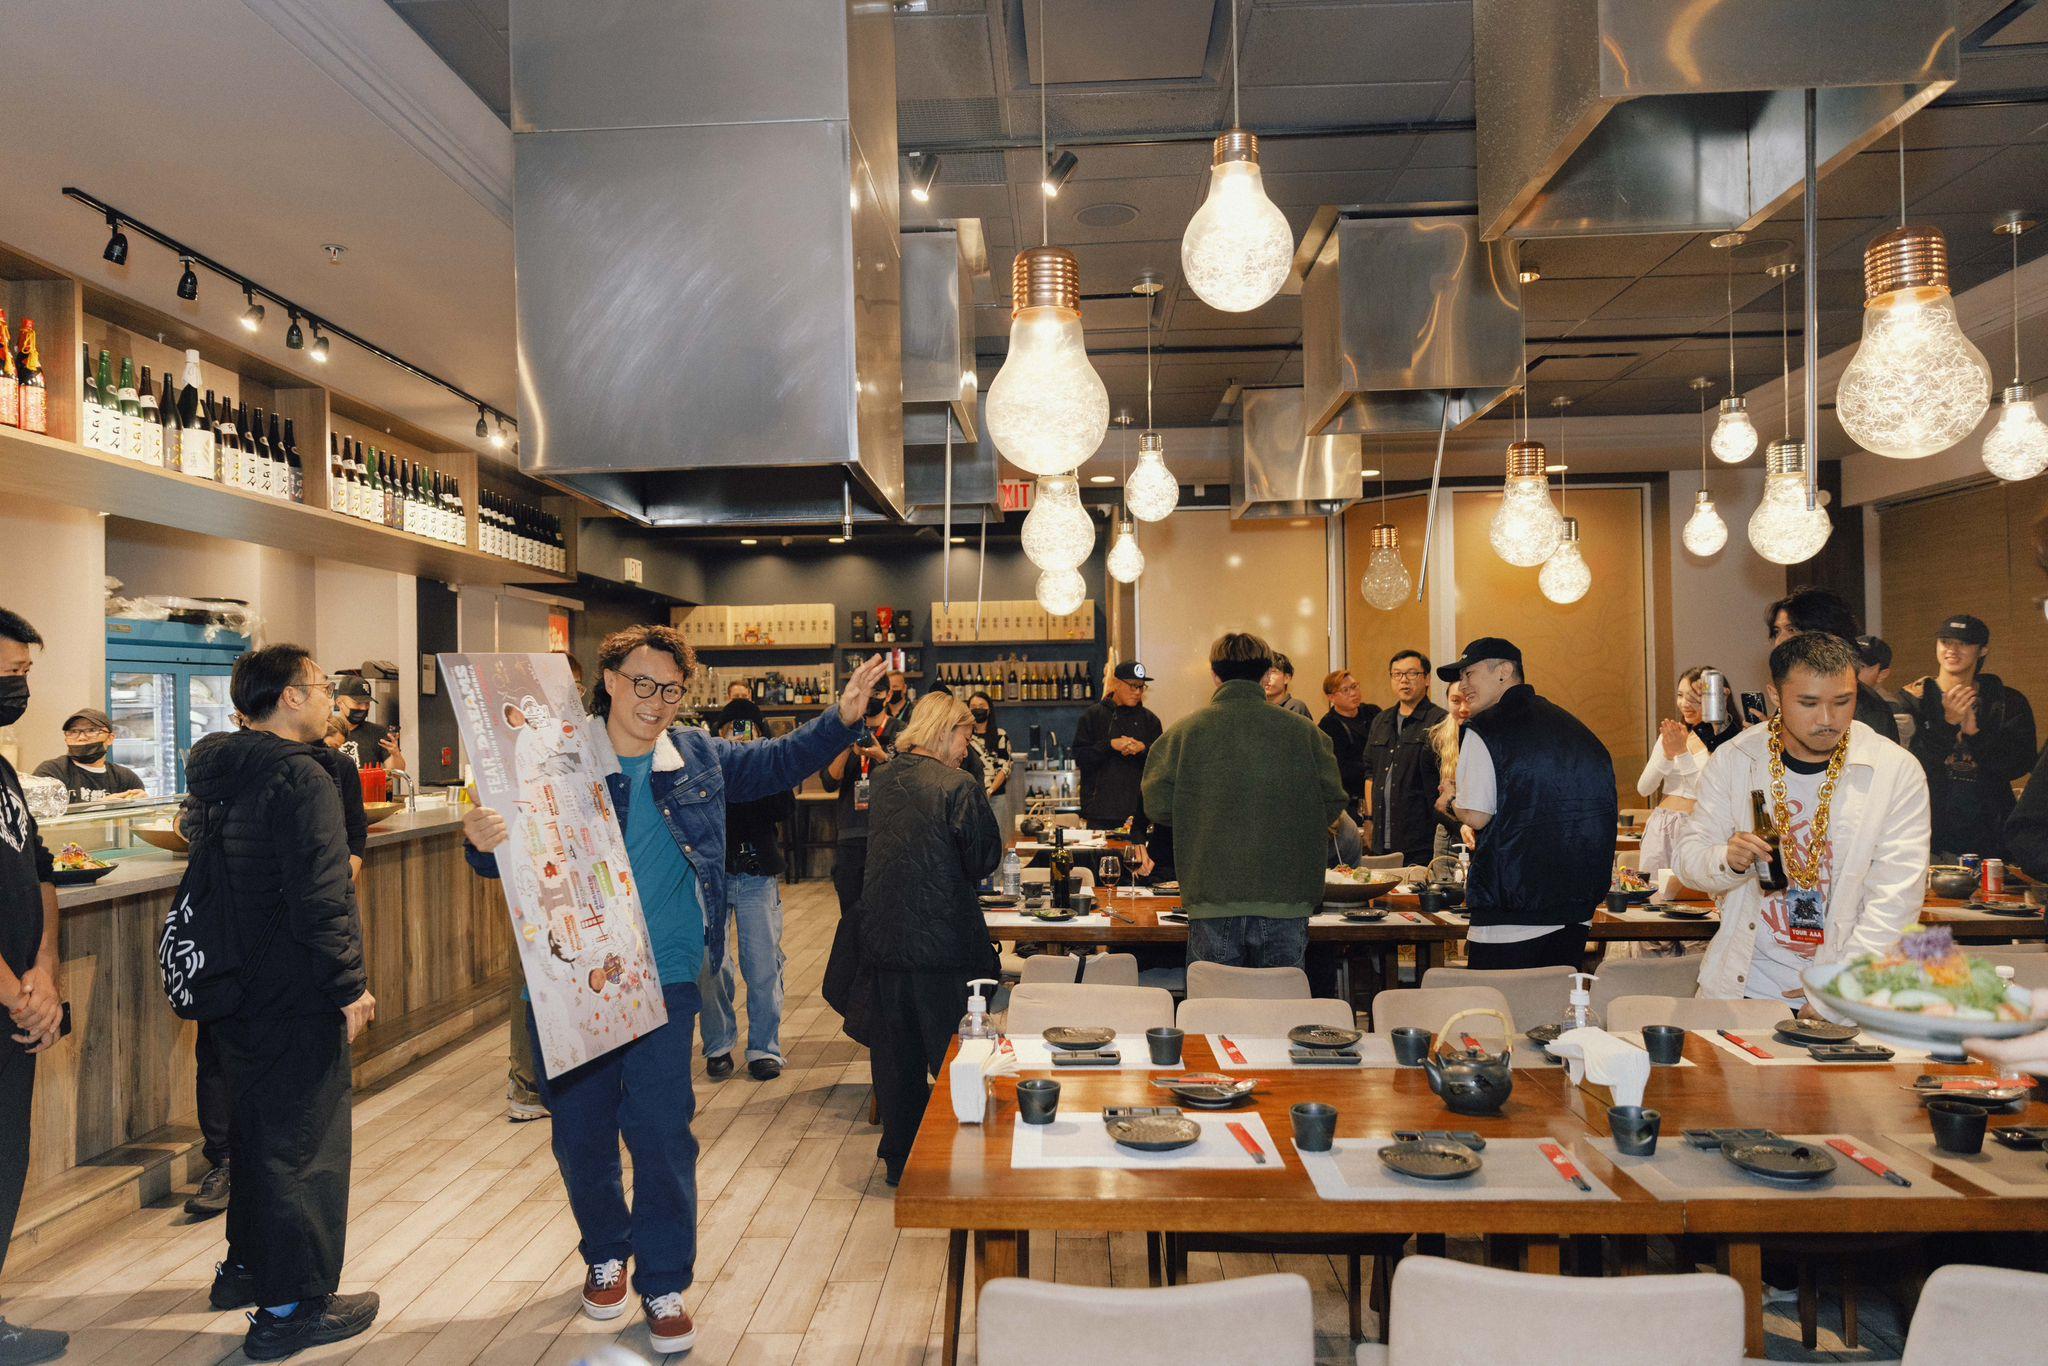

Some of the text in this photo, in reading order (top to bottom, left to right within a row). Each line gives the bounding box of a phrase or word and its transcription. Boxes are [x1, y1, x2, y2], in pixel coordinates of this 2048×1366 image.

[999, 484, 1030, 508] XIT
[468, 664, 483, 700] AMERICA
[454, 665, 490, 750] DREAMS
[481, 702, 493, 728] NORTH
[481, 756, 503, 794] FEAR
[498, 762, 512, 791] WORLD
